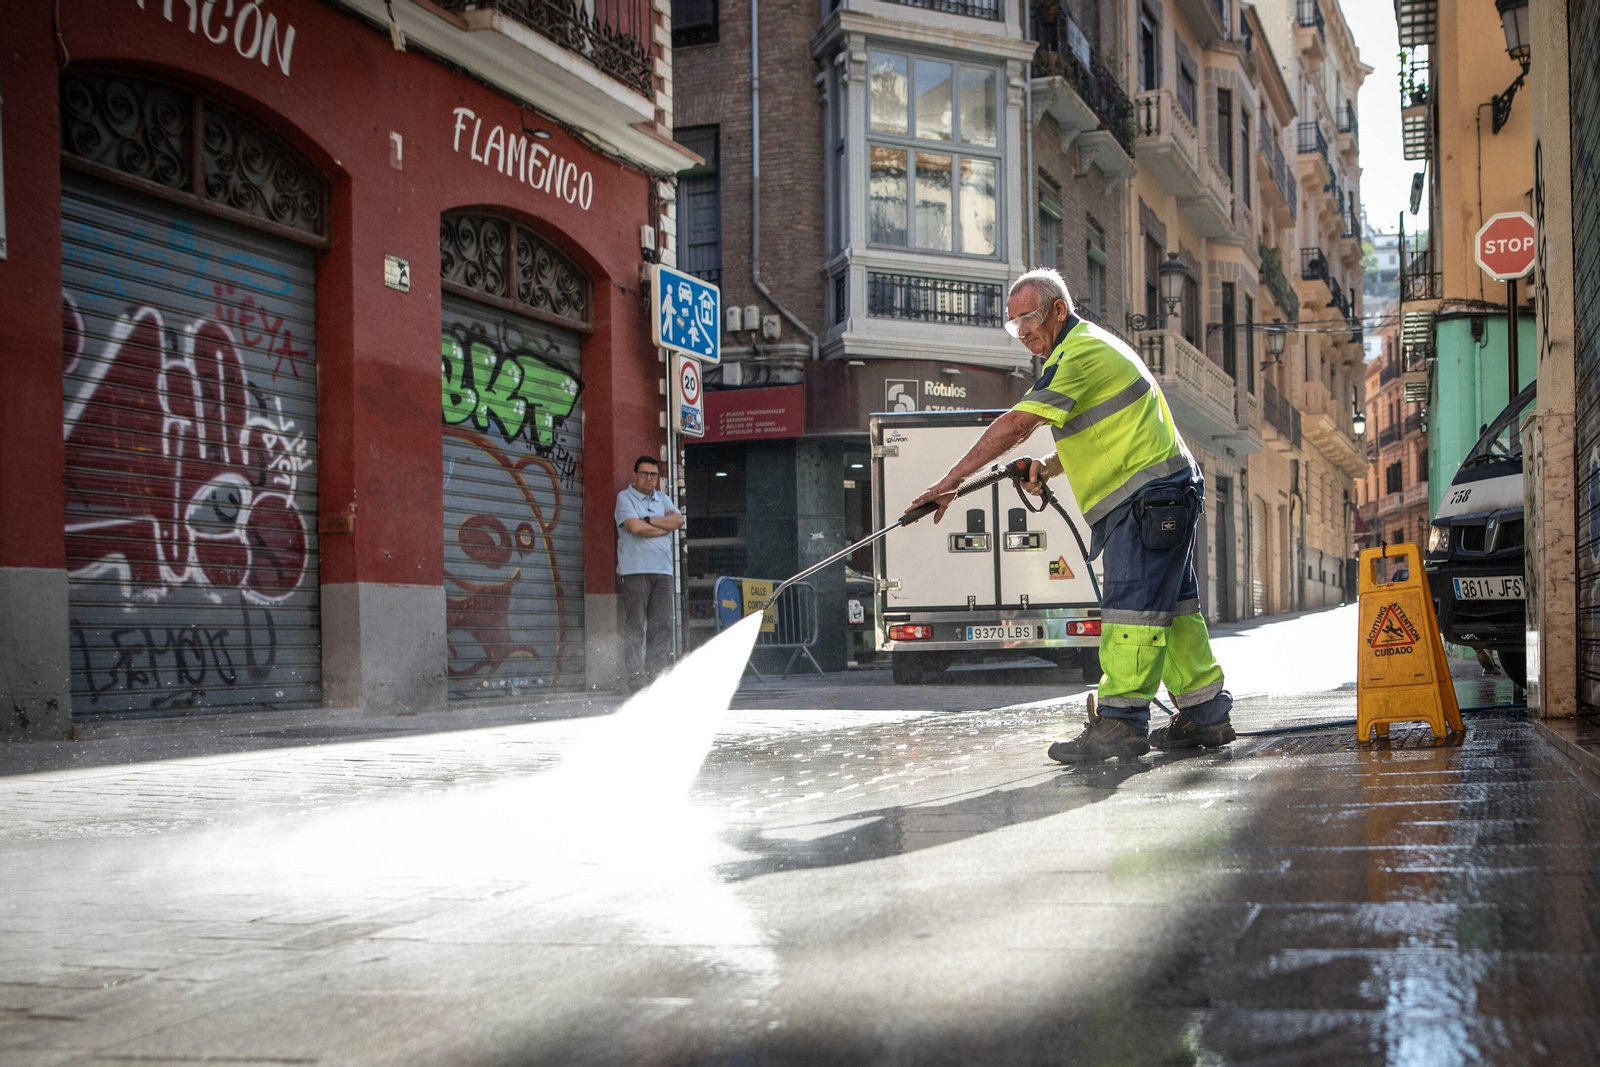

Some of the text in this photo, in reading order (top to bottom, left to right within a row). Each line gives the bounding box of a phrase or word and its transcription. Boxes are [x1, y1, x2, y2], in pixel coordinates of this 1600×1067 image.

[452, 107, 593, 211] FLAMENCO
[1484, 237, 1534, 254] STOP
[684, 375, 696, 391] 20
[924, 380, 966, 398] Rótulos
[746, 408, 786, 416] PROFESIONALES
[1450, 488, 1472, 505] 758
[750, 586, 766, 596] CALLE
[1462, 579, 1521, 598] 3611 JFS
[1366, 605, 1387, 645] ACHTUNG
[1391, 602, 1421, 641] ATTENTION
[974, 627, 1004, 639] 9370
[1007, 626, 1030, 638] LBS
[1374, 646, 1413, 657] CUIDADO
